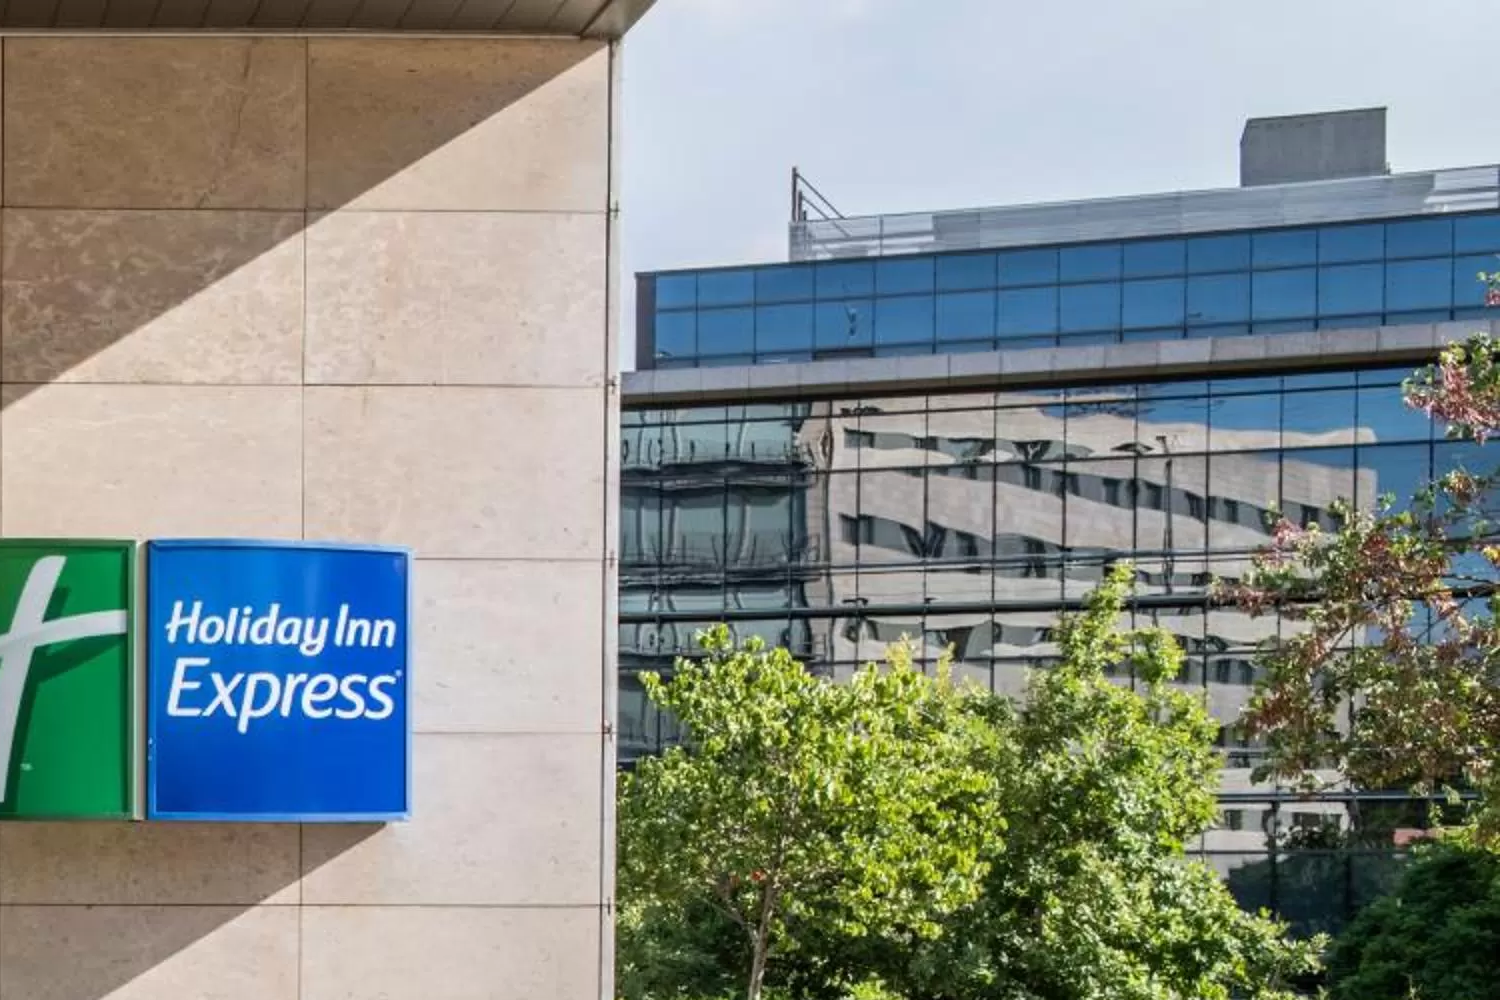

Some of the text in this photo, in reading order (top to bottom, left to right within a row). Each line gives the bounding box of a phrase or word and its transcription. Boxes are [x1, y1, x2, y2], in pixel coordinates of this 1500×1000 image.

[165, 600, 396, 657] Holiday Inn
[167, 657, 397, 734] Express
